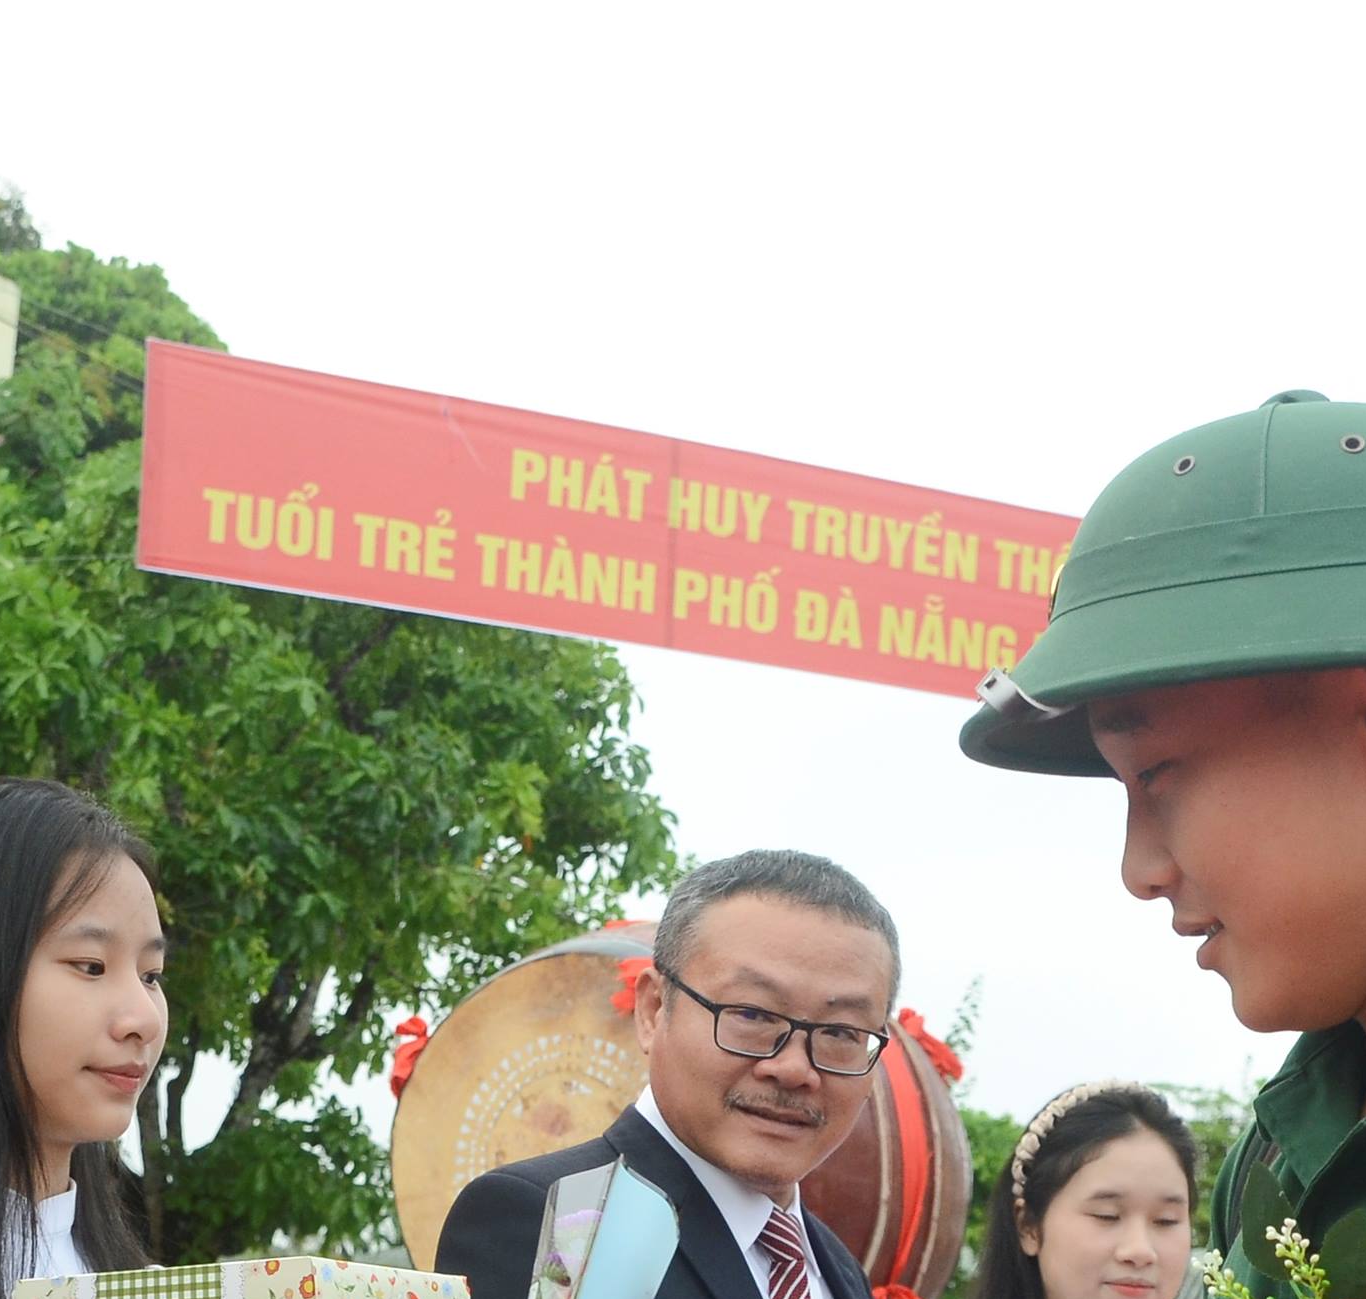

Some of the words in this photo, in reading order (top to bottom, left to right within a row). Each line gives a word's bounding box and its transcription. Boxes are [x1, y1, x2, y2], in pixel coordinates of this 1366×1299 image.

[202, 482, 335, 561] TUỔI
[353, 508, 458, 582] TRẺ
[475, 532, 657, 614] THÀNH
[673, 566, 782, 634] PHỐ
[794, 587, 864, 650] ĐÀ
[878, 594, 1019, 673] NẴNG
[510, 448, 653, 522] PHÁT
[668, 477, 772, 543] HUY
[786, 499, 980, 584] TRUYỀN
